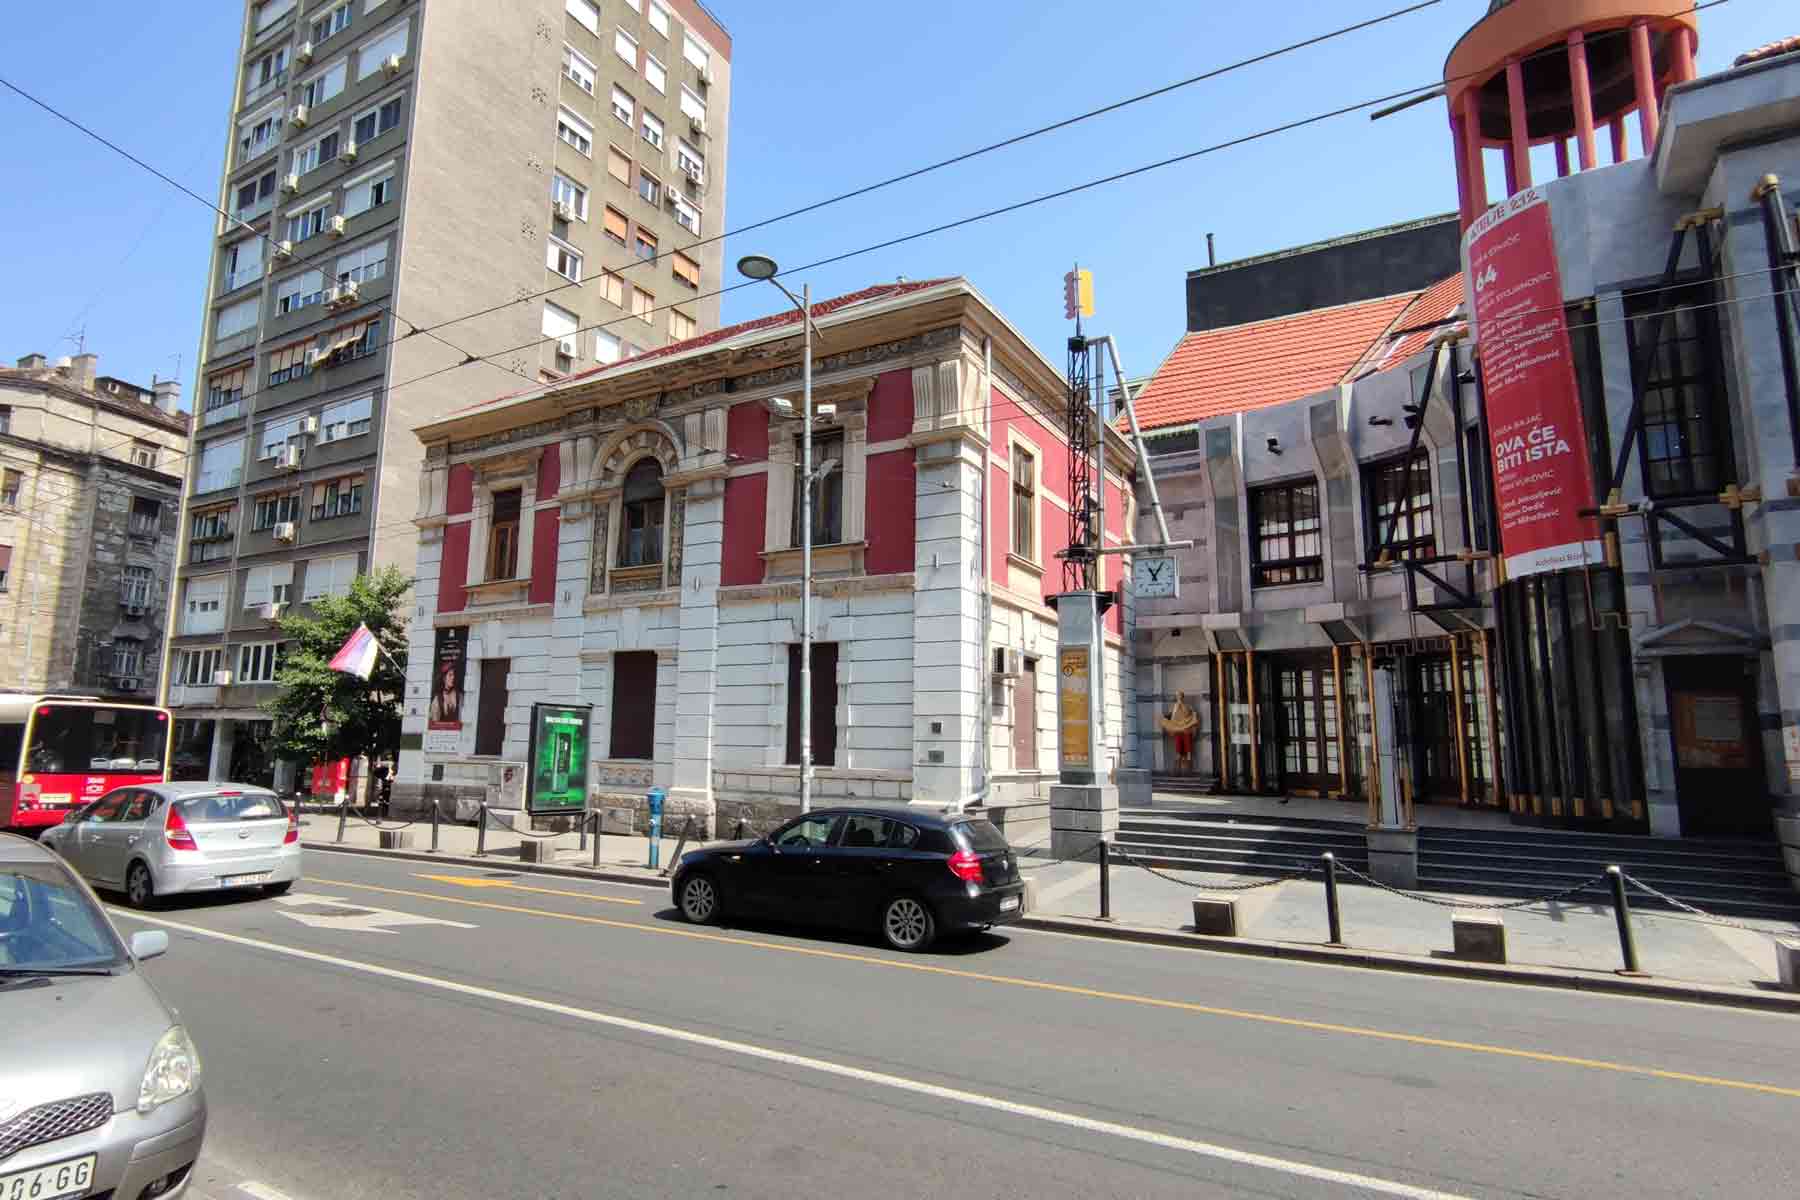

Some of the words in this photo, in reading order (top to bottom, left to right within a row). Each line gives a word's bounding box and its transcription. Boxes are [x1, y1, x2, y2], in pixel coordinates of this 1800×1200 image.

[1510, 190, 1541, 209] 212
[1495, 435, 1525, 457] OVA
[1527, 425, 1557, 445] ĆE
[1496, 452, 1522, 474] BITI
[1525, 439, 1571, 462] ISTA
